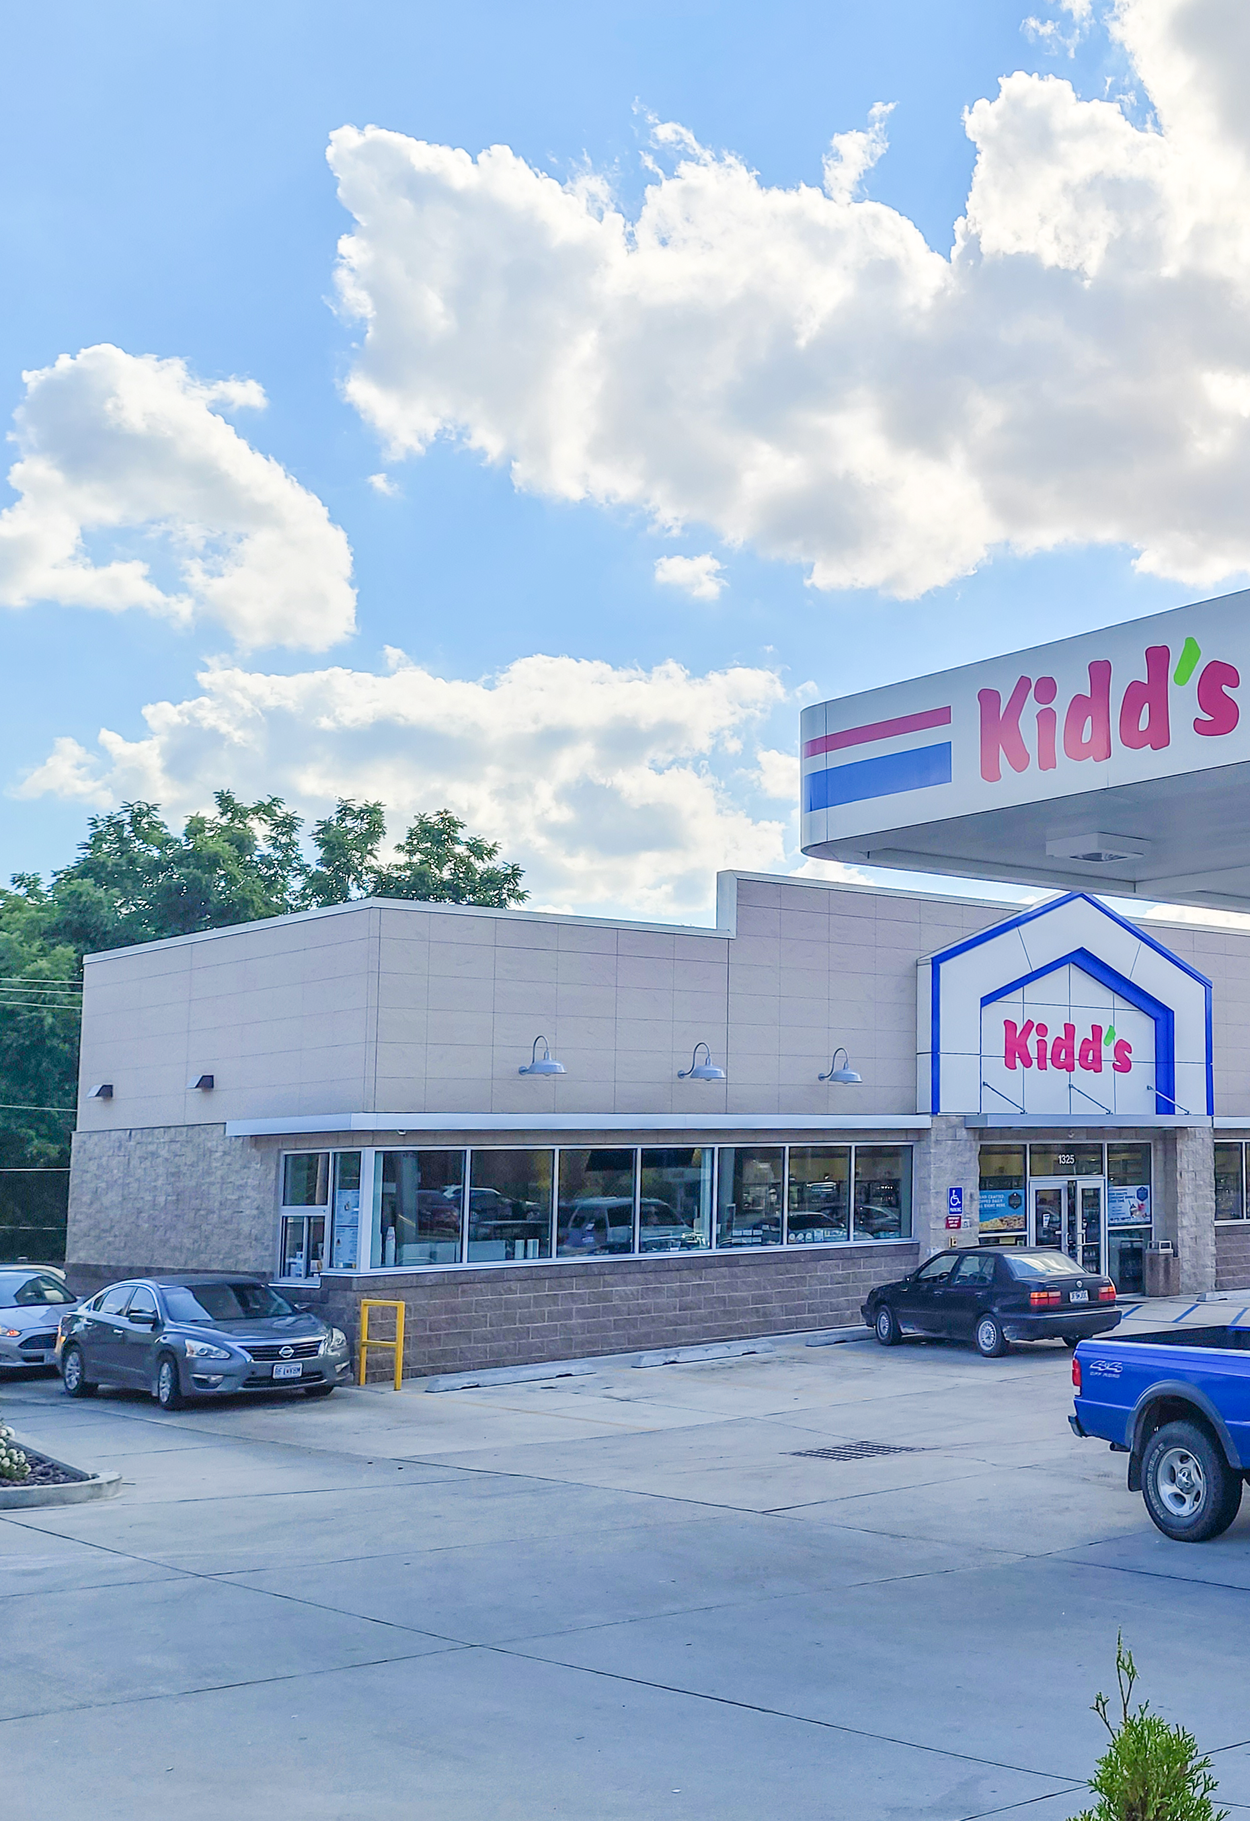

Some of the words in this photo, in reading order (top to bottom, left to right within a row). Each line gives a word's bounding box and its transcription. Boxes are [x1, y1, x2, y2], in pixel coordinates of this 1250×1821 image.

[977, 637, 1240, 783] Kidd's
[1003, 1019, 1132, 1073] Kidd's
[1058, 1154, 1075, 1165] 1325
